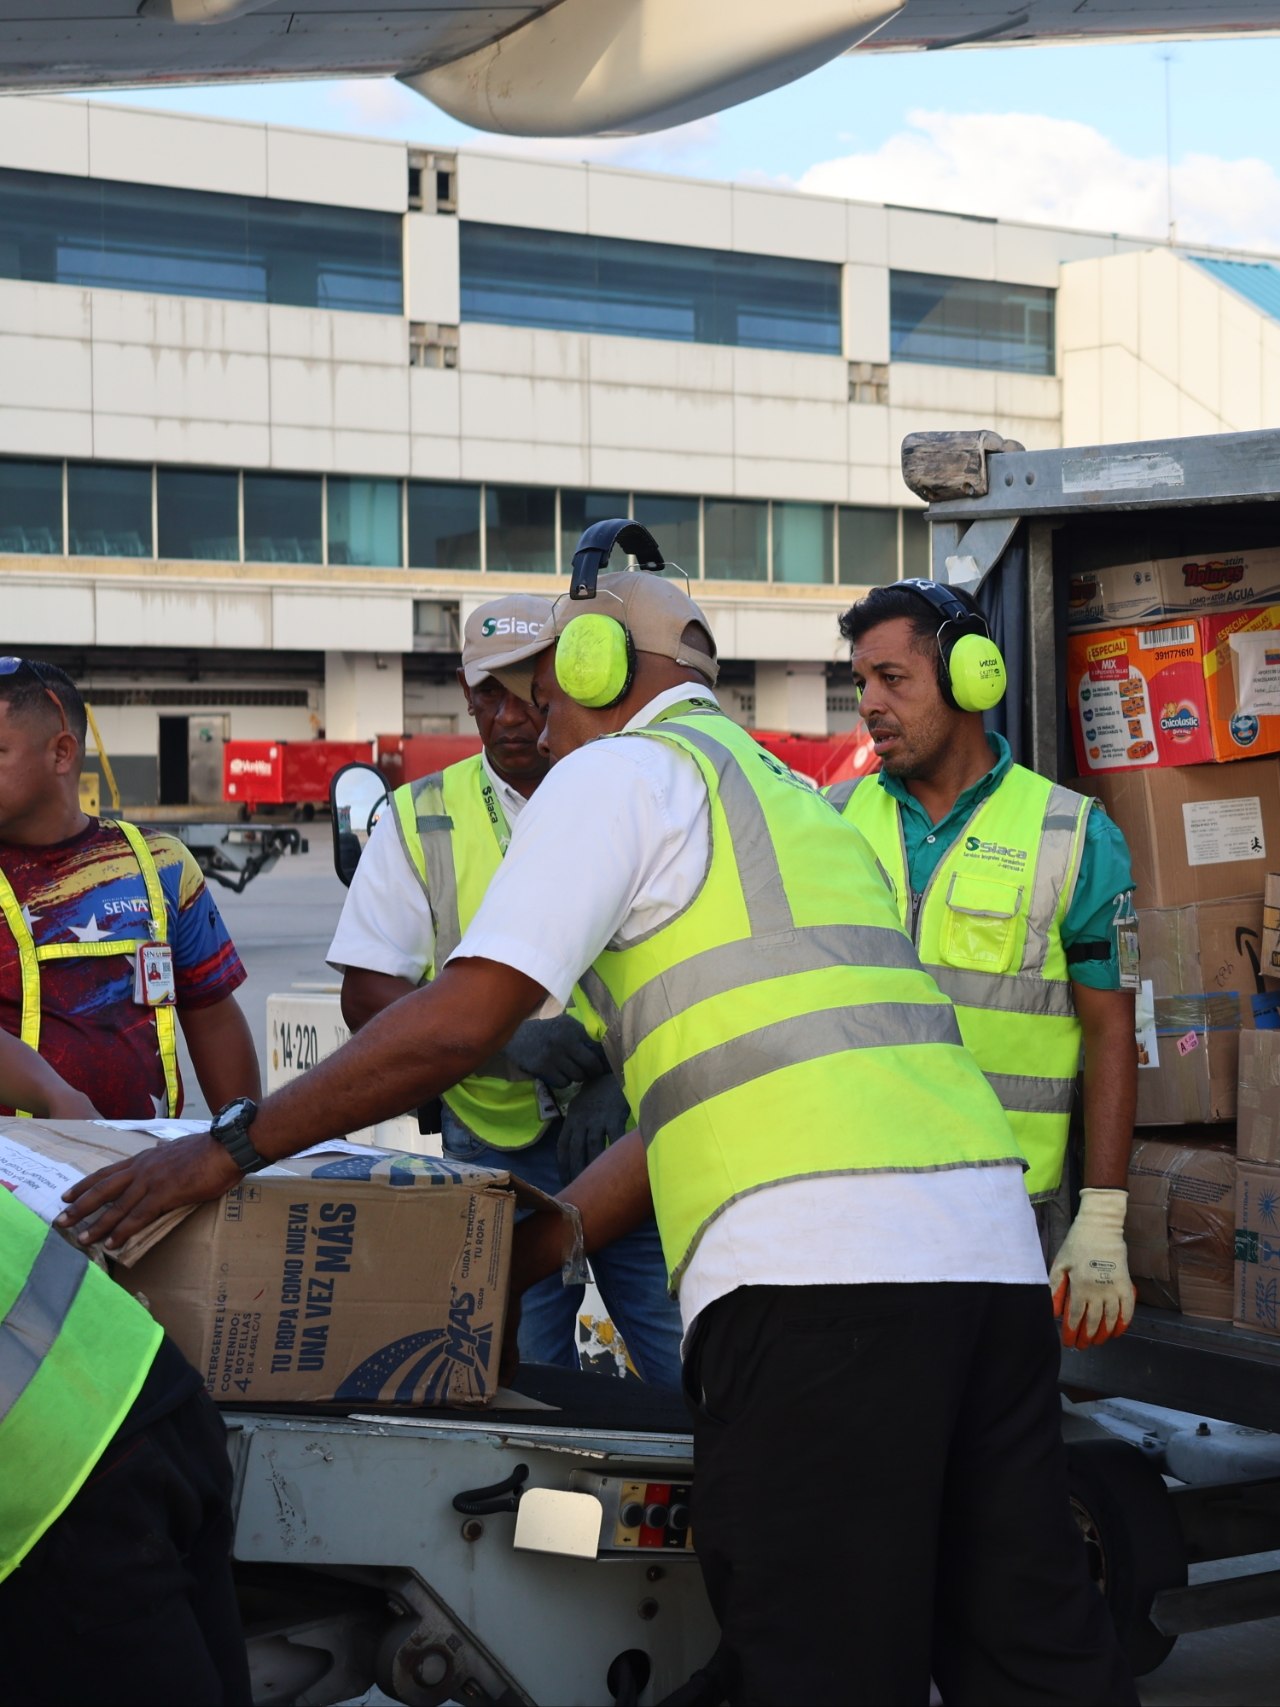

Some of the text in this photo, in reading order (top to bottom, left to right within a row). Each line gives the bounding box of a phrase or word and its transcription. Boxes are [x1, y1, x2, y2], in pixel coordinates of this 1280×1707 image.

[1226, 587, 1255, 601] AGUA
[496, 616, 544, 636] Siac
[1101, 660, 1117, 670] MIX
[104, 899, 149, 915] SENIA
[460, 1194, 478, 1279] CUIDA Y RENUEVA
[474, 1219, 485, 1259] TU ROPA
[270, 1203, 309, 1374] TU ROPA COMO NUEVA
[297, 1203, 357, 1372] UNA VEZ MÁS
[477, 1288, 485, 1310] COLOR
[206, 1317, 225, 1392] DETERGENTE
[221, 1313, 241, 1392] CONTENIDO:
[233, 1313, 252, 1393] 4 BOTELLAS
[245, 1361, 255, 1374] DE
[250, 1312, 261, 1332] C/U
